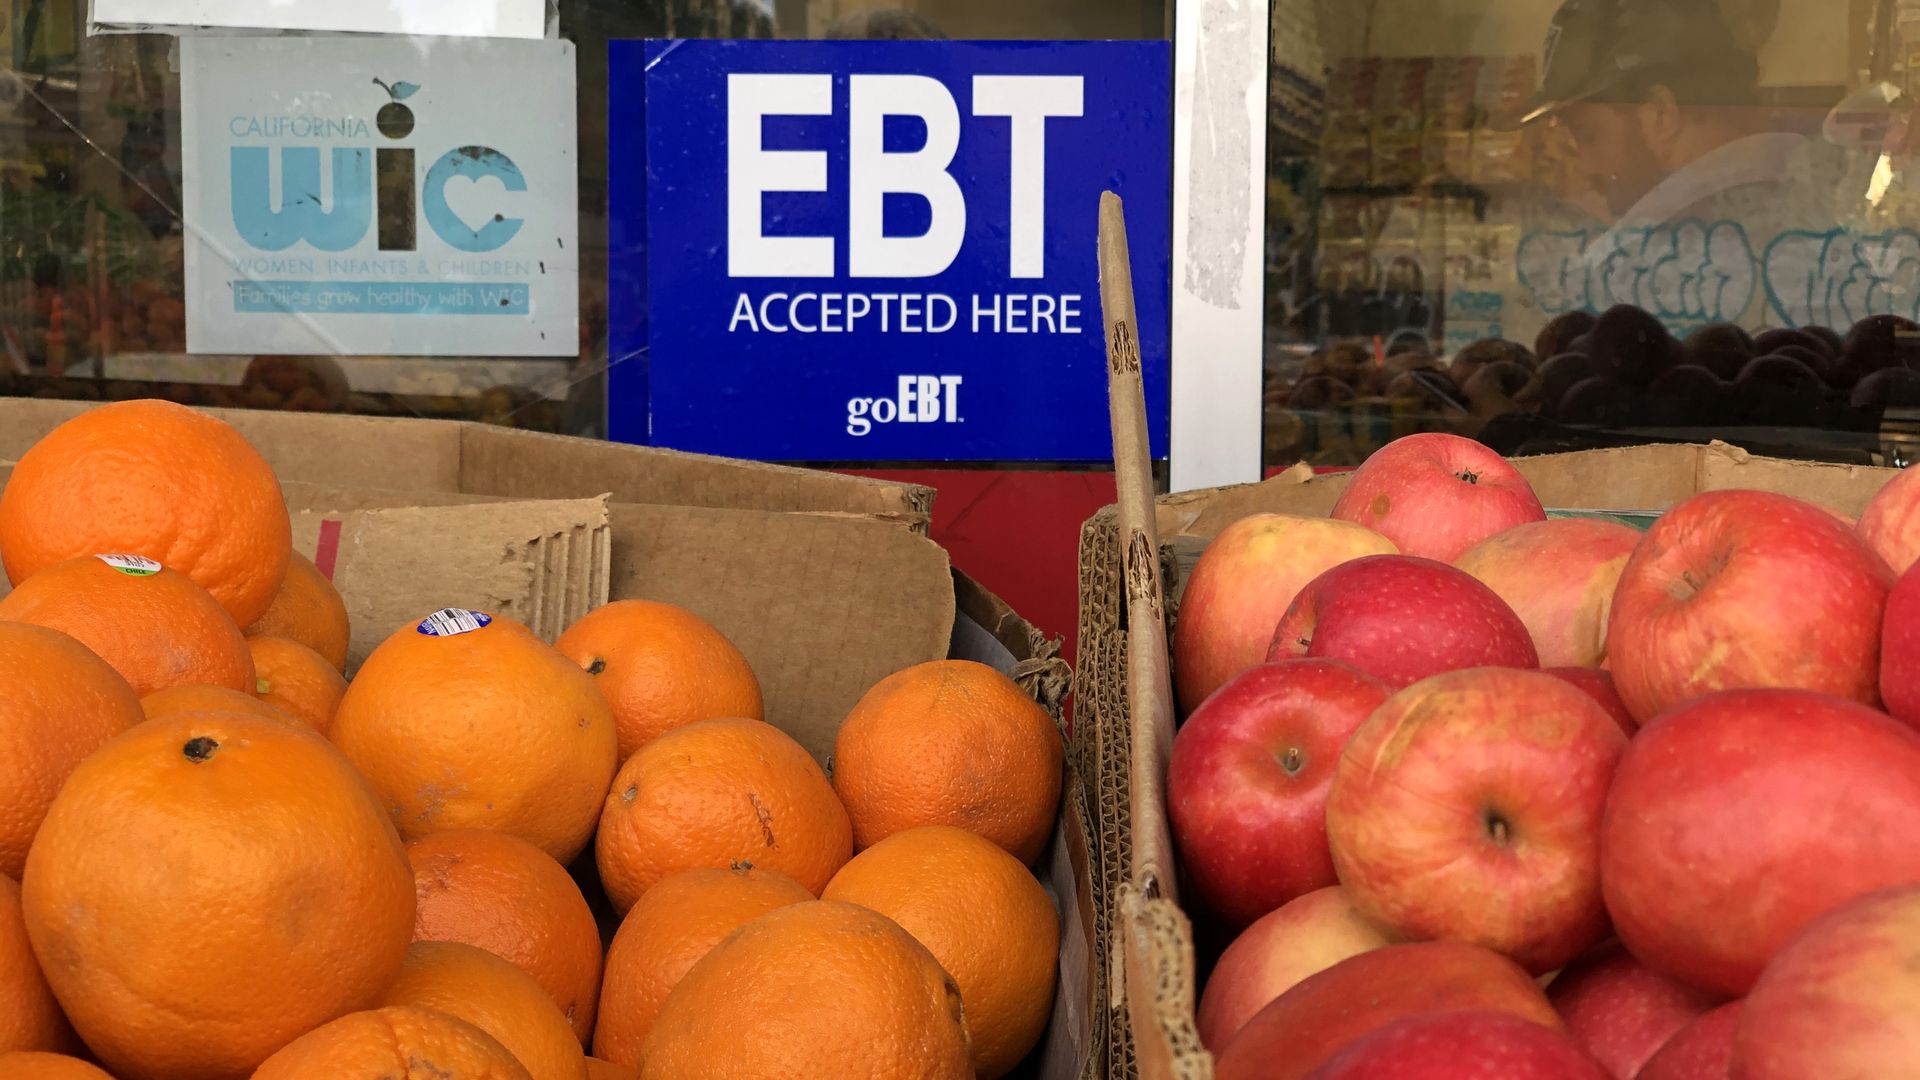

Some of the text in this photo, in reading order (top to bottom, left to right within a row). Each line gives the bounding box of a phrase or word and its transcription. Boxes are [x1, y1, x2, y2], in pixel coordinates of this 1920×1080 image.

[229, 115, 371, 138] CALIFORNIA
[727, 73, 1085, 279] EBT
[327, 257, 409, 276] INFANTS
[417, 259, 430, 276] &
[437, 259, 530, 277] CHILDREN
[239, 284, 524, 313] Families grow healthy with WIC
[728, 293, 1082, 334] ACCEPTED HERE
[846, 375, 963, 437] goEBT
